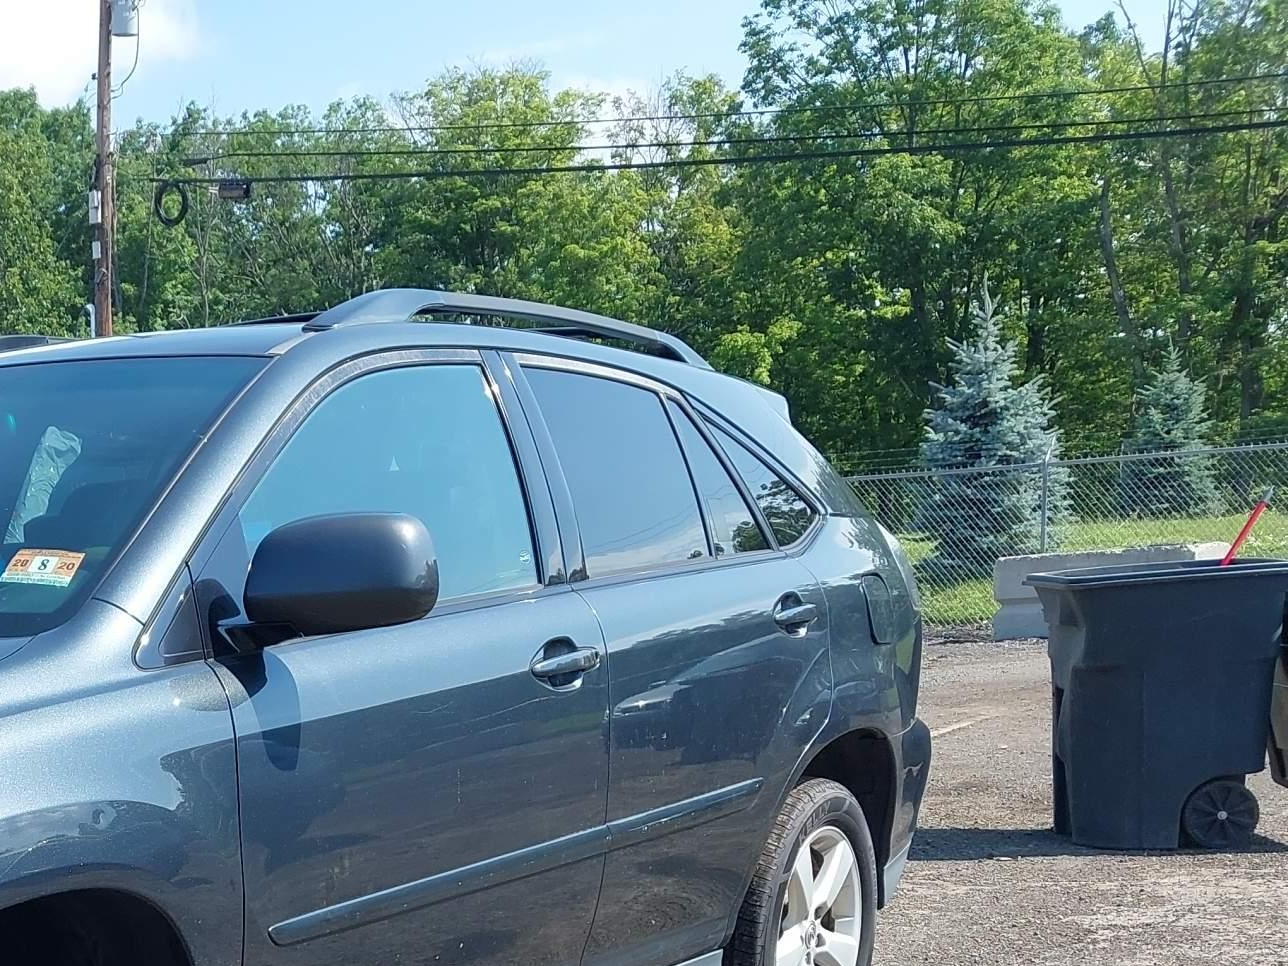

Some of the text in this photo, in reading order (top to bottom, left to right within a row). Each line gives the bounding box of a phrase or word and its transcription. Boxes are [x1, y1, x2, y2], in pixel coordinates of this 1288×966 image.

[12, 558, 76, 571] 20 8 20
[798, 799, 831, 847] KELLY
